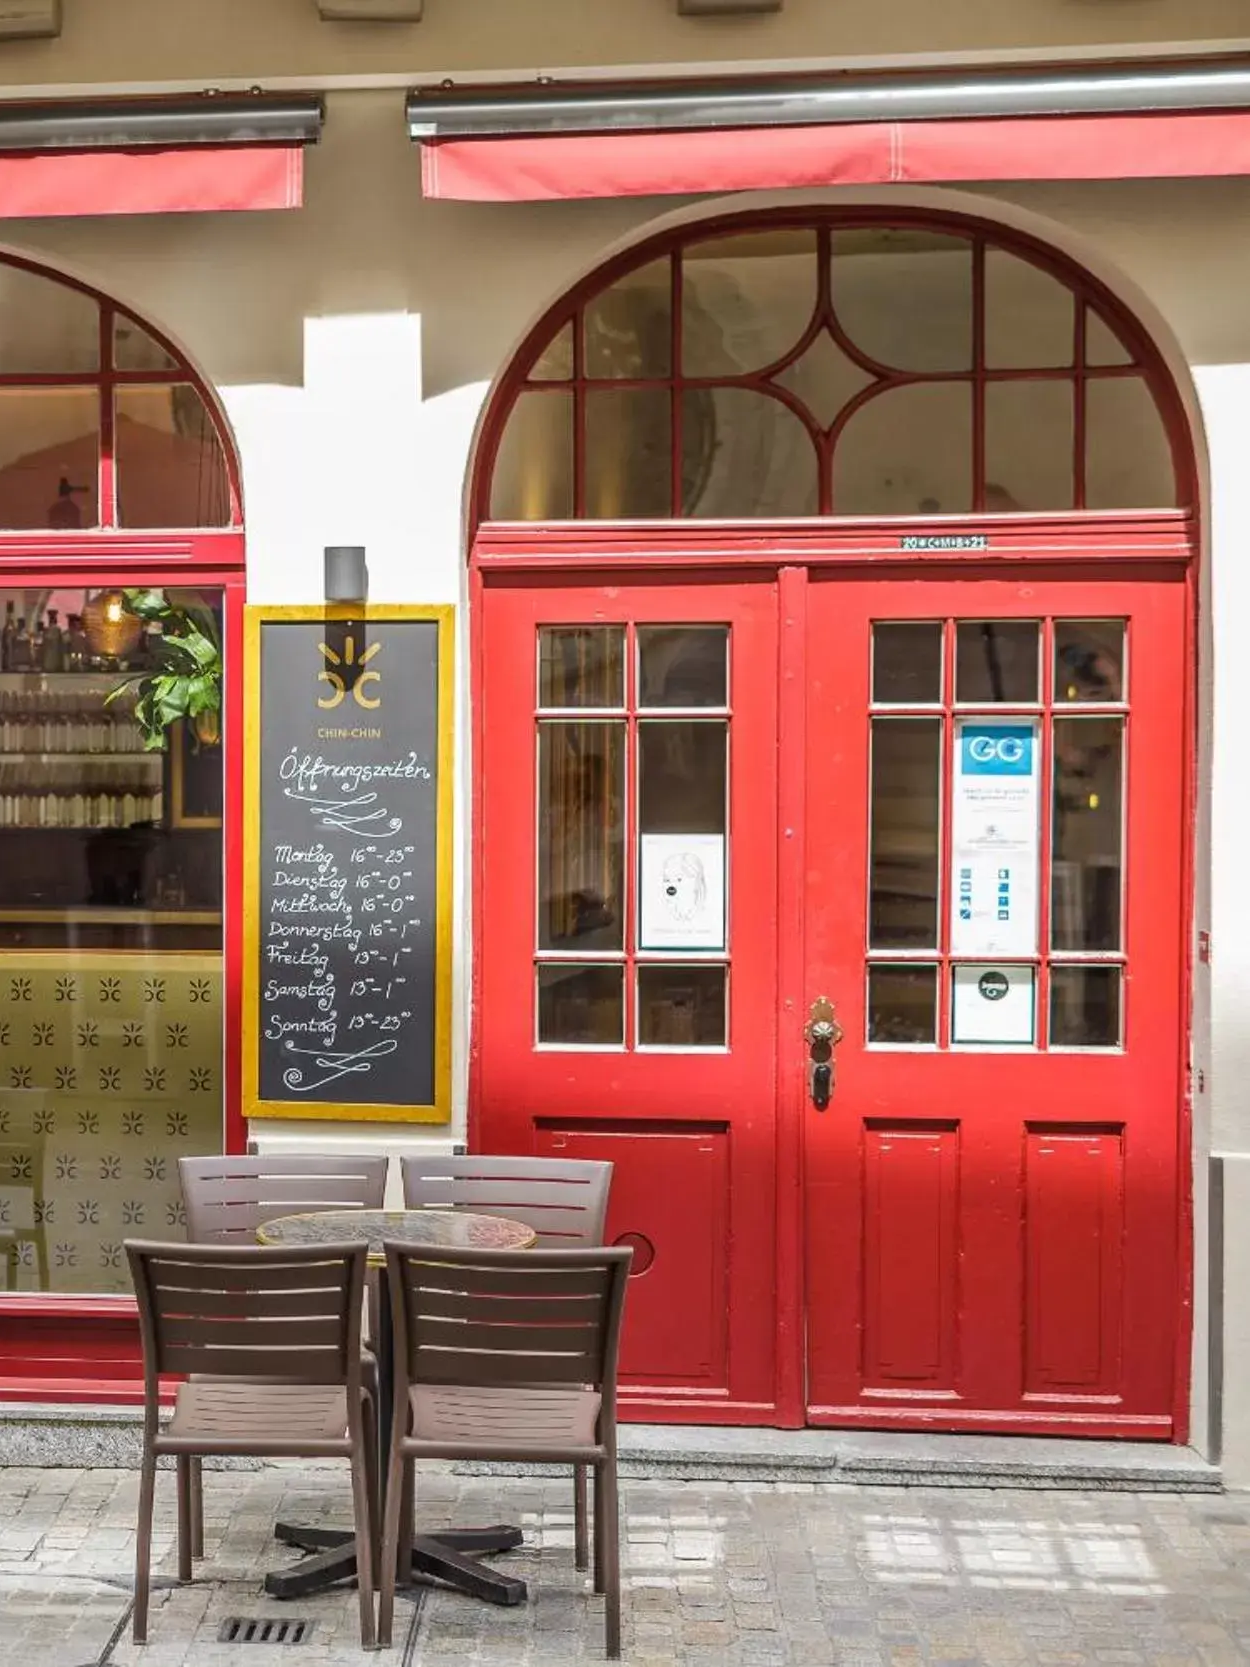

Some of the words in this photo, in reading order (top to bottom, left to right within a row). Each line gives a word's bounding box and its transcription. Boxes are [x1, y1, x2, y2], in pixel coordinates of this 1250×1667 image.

[317, 727, 382, 739] CHIN-CHIN
[279, 747, 431, 793] Öffnungszeiten
[275, 843, 334, 873] Montag
[272, 867, 348, 899] Dienstag
[270, 893, 353, 914] Mittwoch
[267, 915, 362, 951] Donnerstag
[265, 941, 329, 978] Freitag
[264, 973, 336, 1011] Samstag
[265, 1010, 338, 1047] Sonntag
